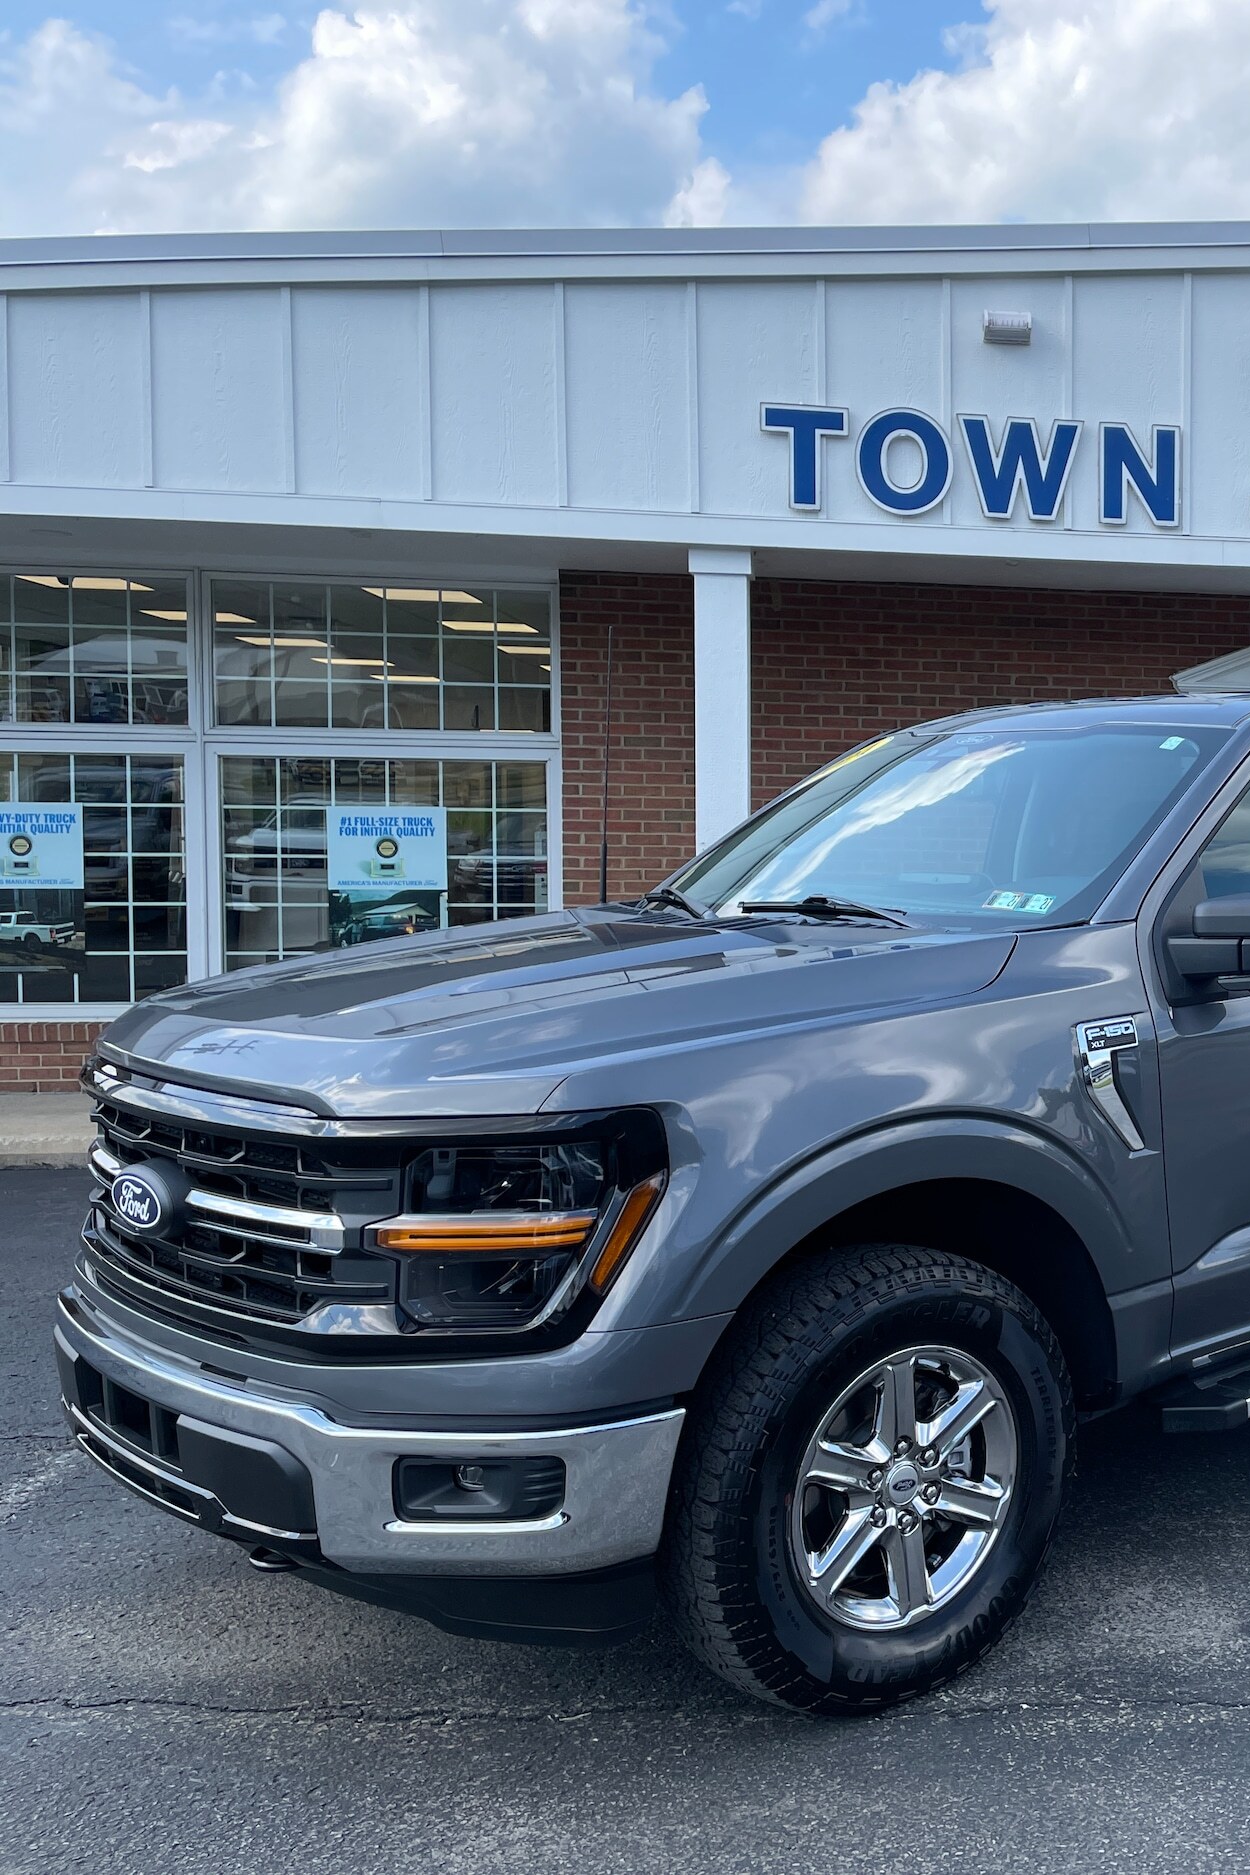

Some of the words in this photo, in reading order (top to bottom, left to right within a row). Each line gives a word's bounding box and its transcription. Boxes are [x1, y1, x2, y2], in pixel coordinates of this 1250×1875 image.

[760, 402, 1183, 527] TOWN
[43, 813, 77, 824] TRUCK
[340, 816, 353, 827] #1
[354, 816, 400, 827] FULL-SIZE
[402, 816, 434, 827] TRUCK
[30, 824, 72, 836] QUALITY
[339, 826, 359, 837] FOR
[360, 826, 394, 837] INITIAL
[396, 827, 436, 839] QUALITY
[1086, 1022, 1135, 1040] F-150
[1091, 1040, 1105, 1048] XLT
[120, 1181, 151, 1221] Ford
[847, 1576, 1026, 1684] GOODYEAR
